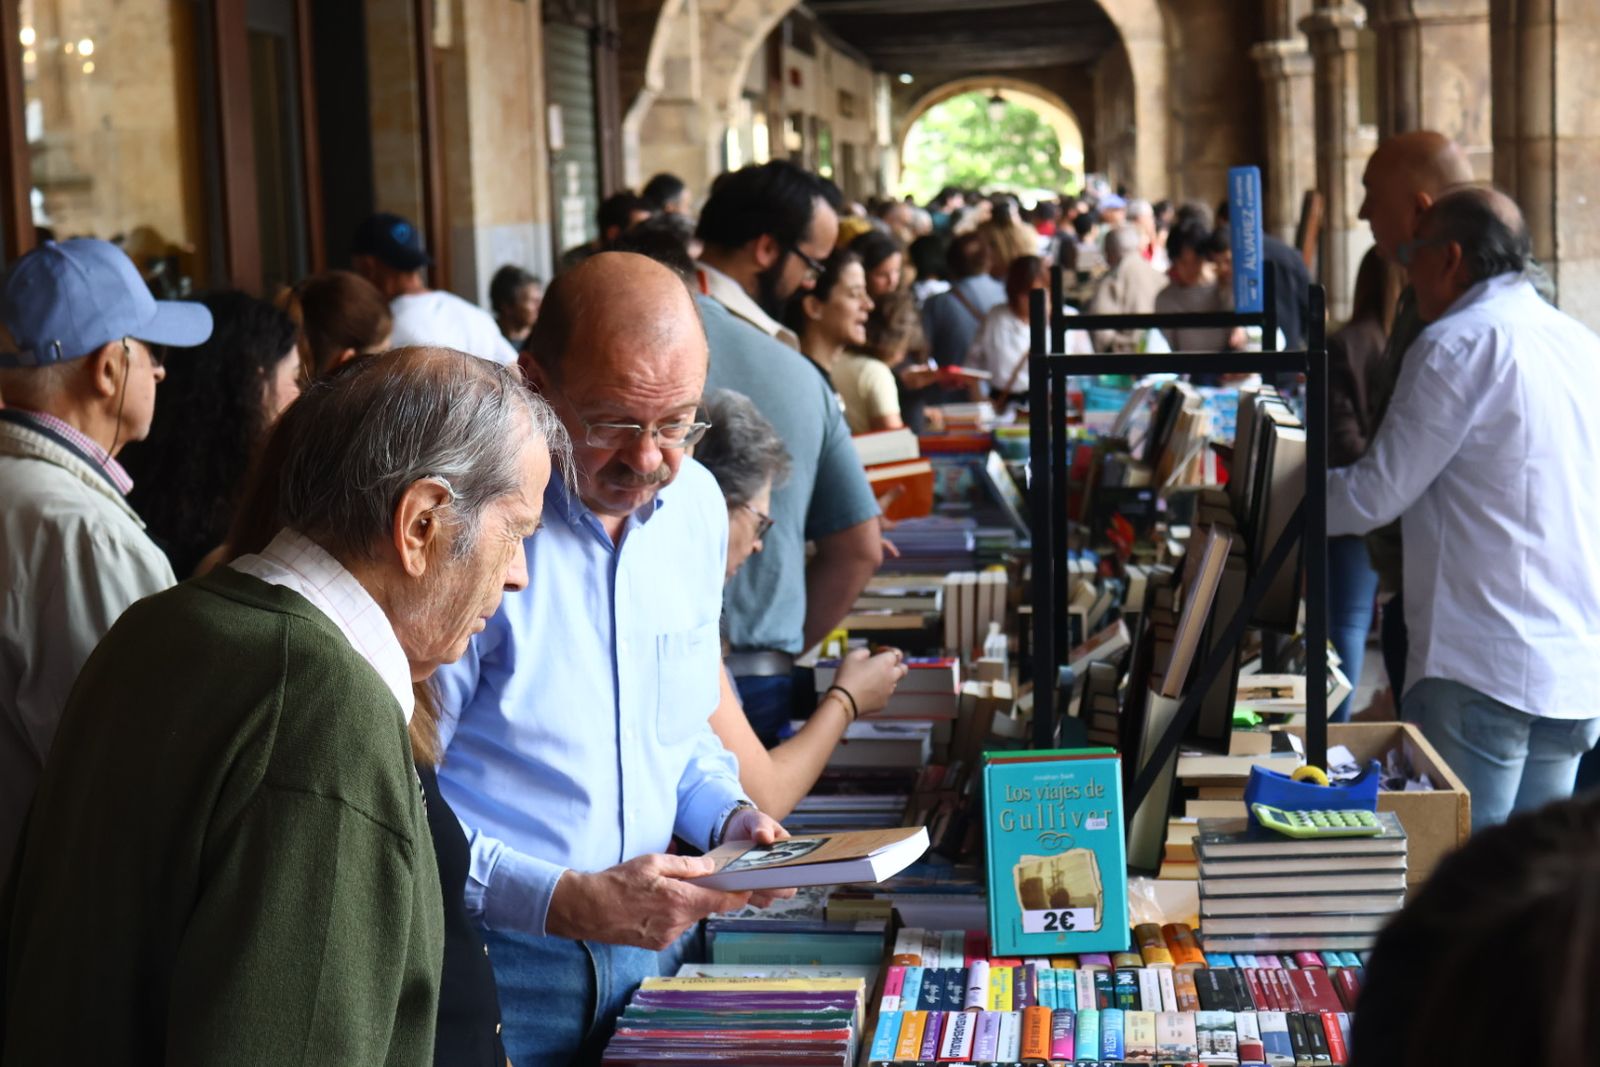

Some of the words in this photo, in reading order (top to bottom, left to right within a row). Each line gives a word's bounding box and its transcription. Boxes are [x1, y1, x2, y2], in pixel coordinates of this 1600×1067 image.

[1005, 784, 1031, 803] Los
[1036, 782, 1080, 806] viajes
[1084, 777, 1104, 798] de
[1043, 911, 1075, 931] 2€
